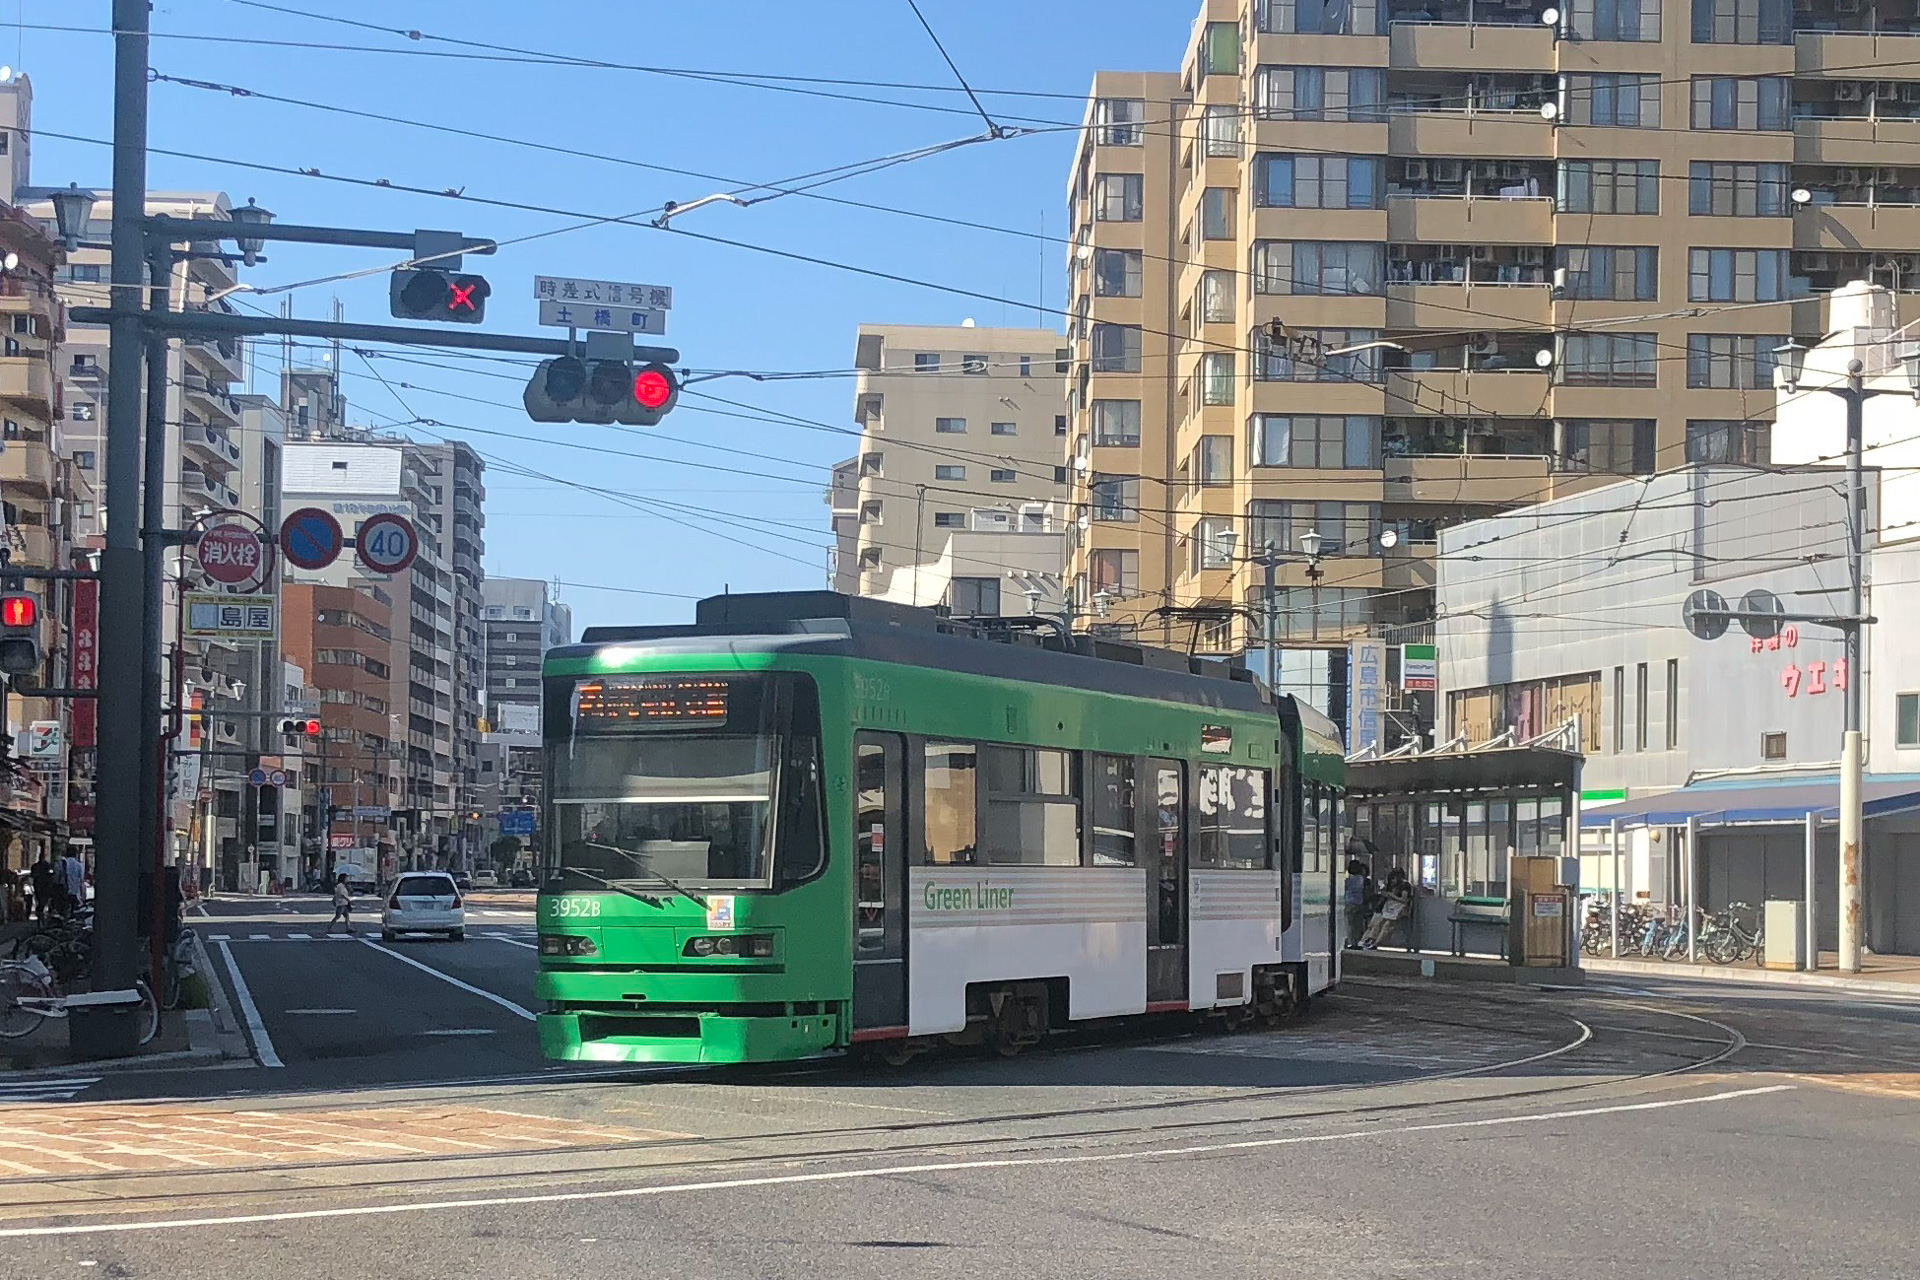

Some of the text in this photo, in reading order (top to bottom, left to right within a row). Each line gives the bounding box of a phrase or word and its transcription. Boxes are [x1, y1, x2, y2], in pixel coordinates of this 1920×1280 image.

[540, 280, 667, 308] 時差式信号機
[556, 306, 649, 330] 土橋町
[203, 540, 255, 567] 消火栓
[370, 529, 404, 557] 40
[549, 898, 602, 918] 3952B
[924, 879, 1016, 911] Green Liner
